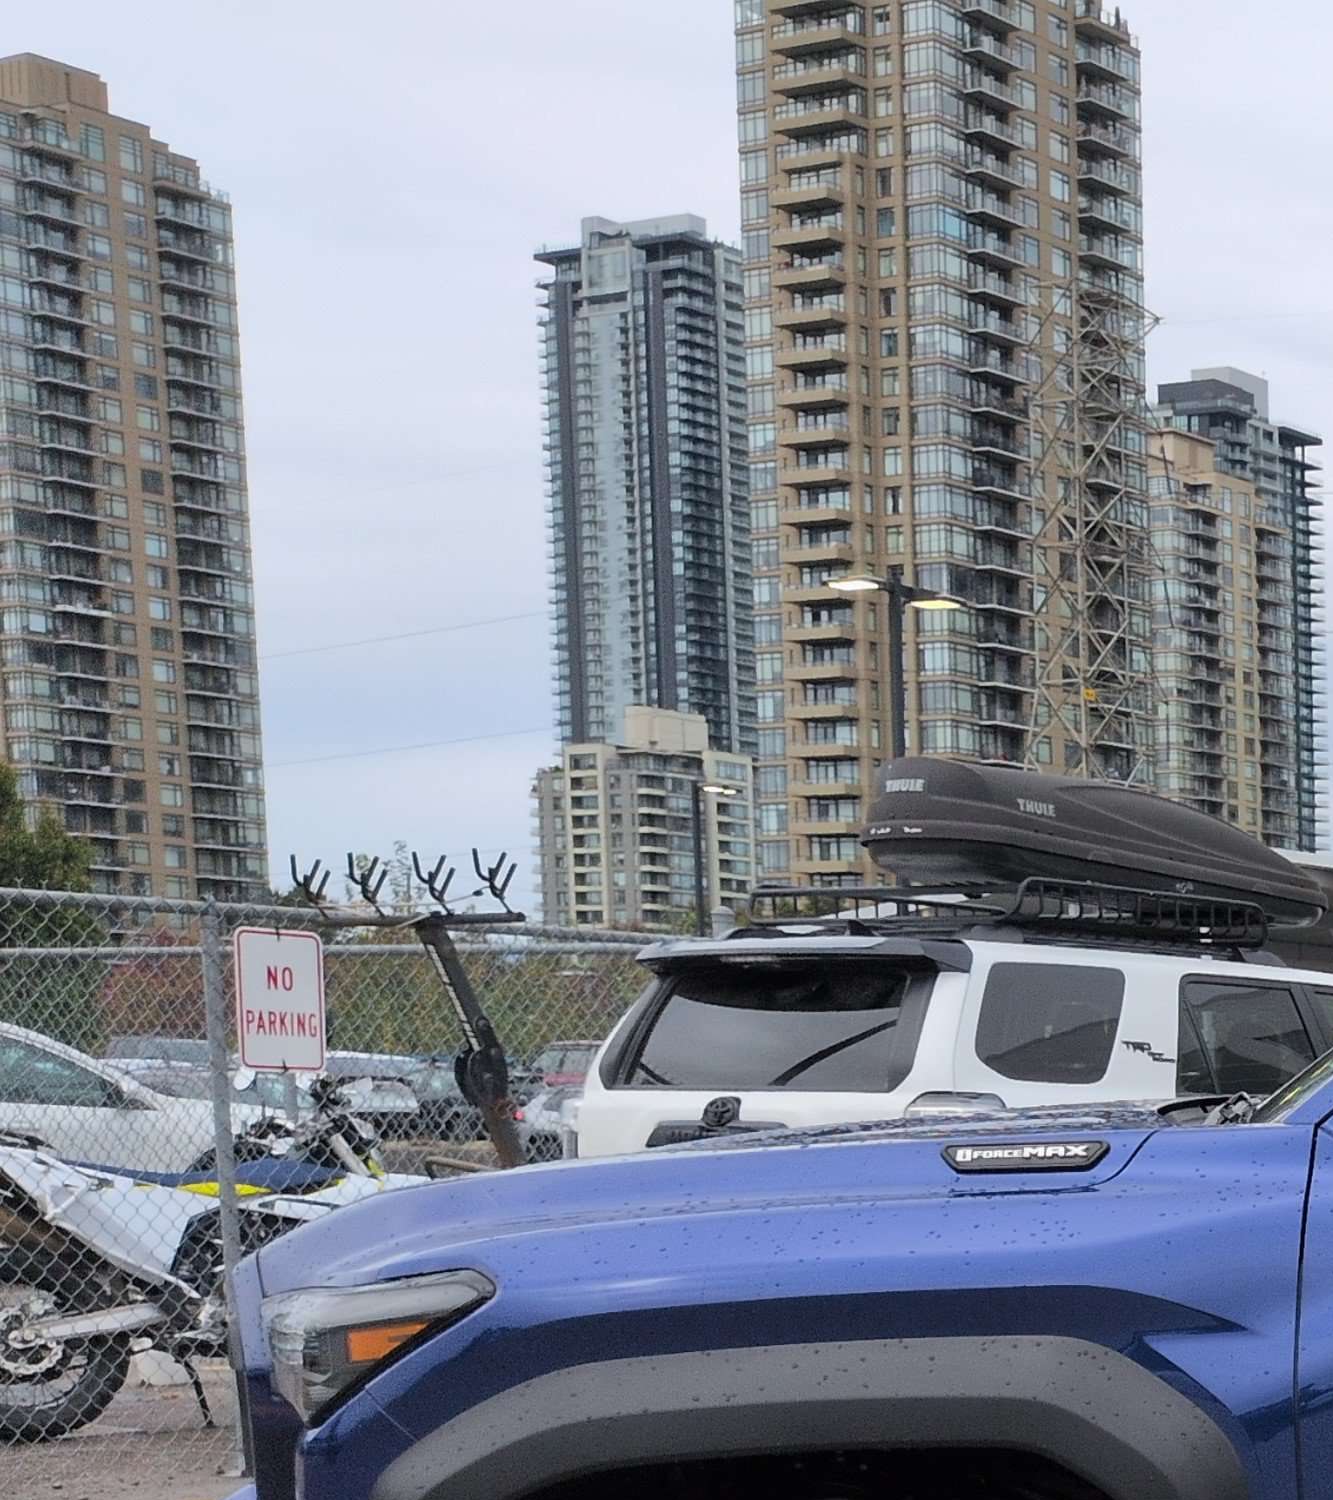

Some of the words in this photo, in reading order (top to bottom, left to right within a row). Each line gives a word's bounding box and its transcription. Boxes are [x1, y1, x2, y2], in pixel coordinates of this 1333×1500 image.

[885, 778, 924, 792] THULE
[1016, 798, 1056, 817] THULE
[266, 965, 293, 992] NO
[245, 1009, 318, 1038] PARKING
